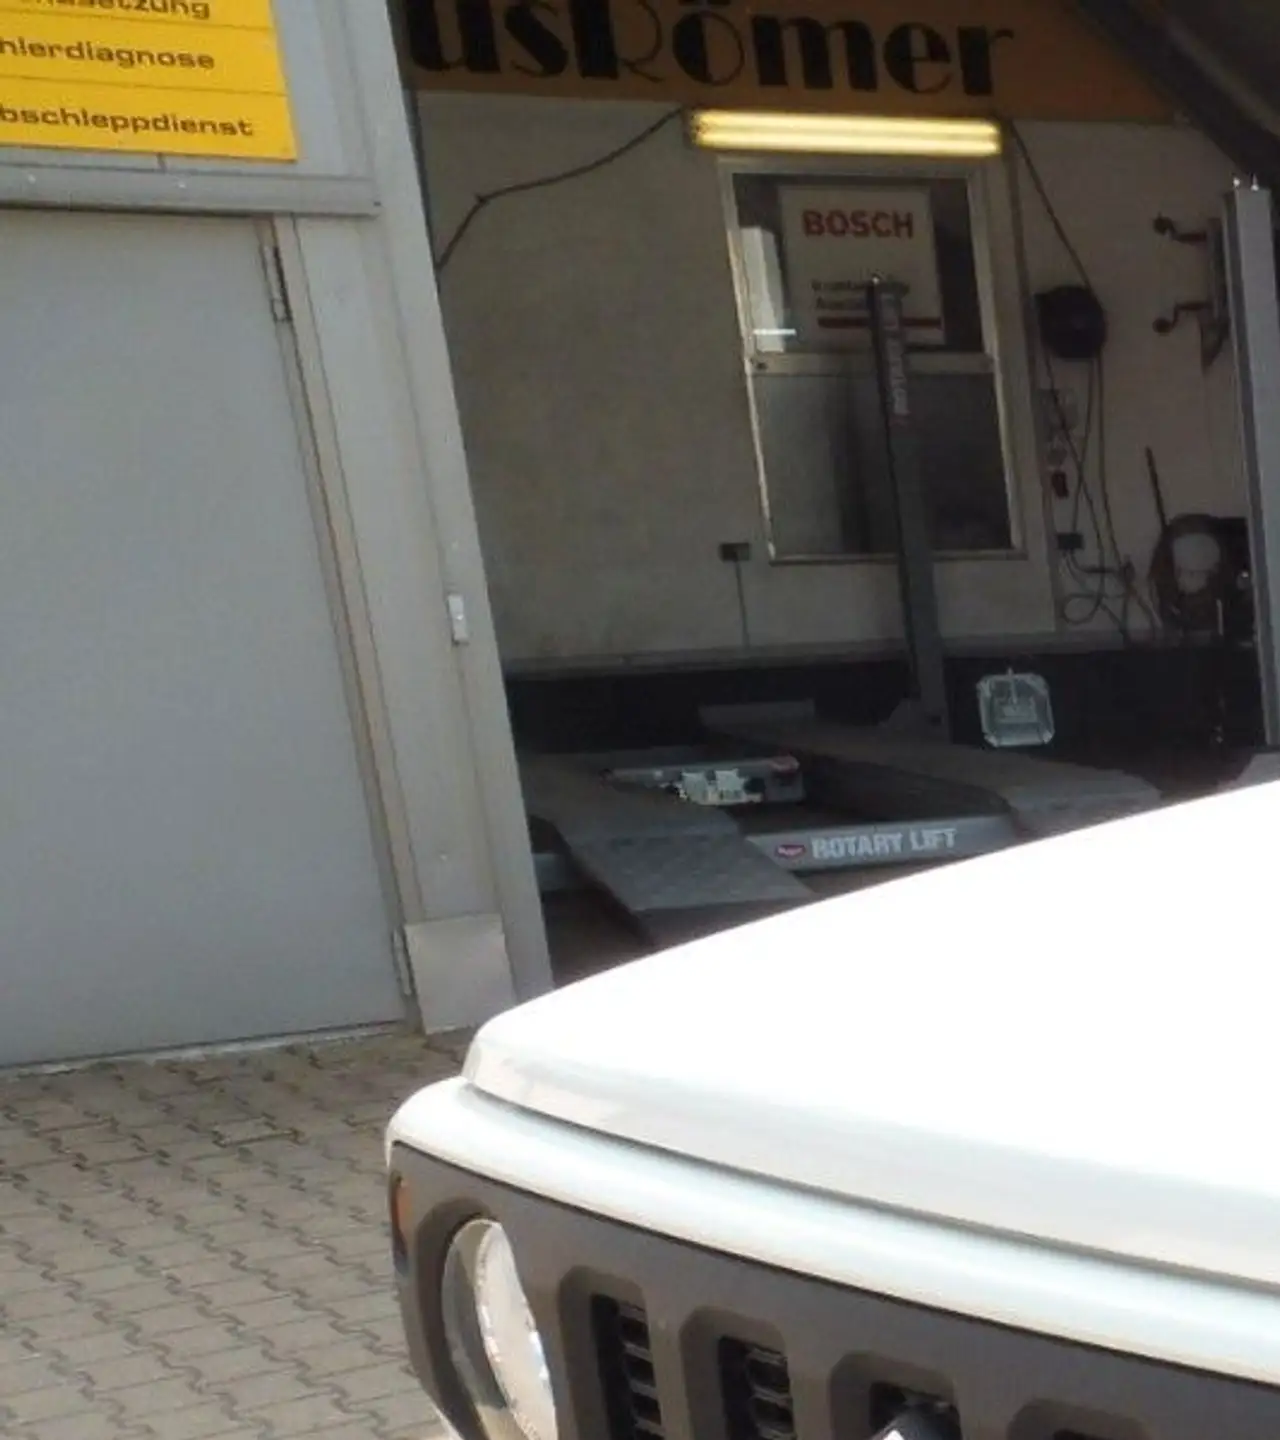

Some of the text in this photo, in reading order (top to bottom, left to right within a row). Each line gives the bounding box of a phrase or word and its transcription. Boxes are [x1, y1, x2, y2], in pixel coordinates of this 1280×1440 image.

[803, 209, 914, 239] BOSCH
[811, 832, 903, 859] ROTARY
[909, 827, 957, 850] LIFT
